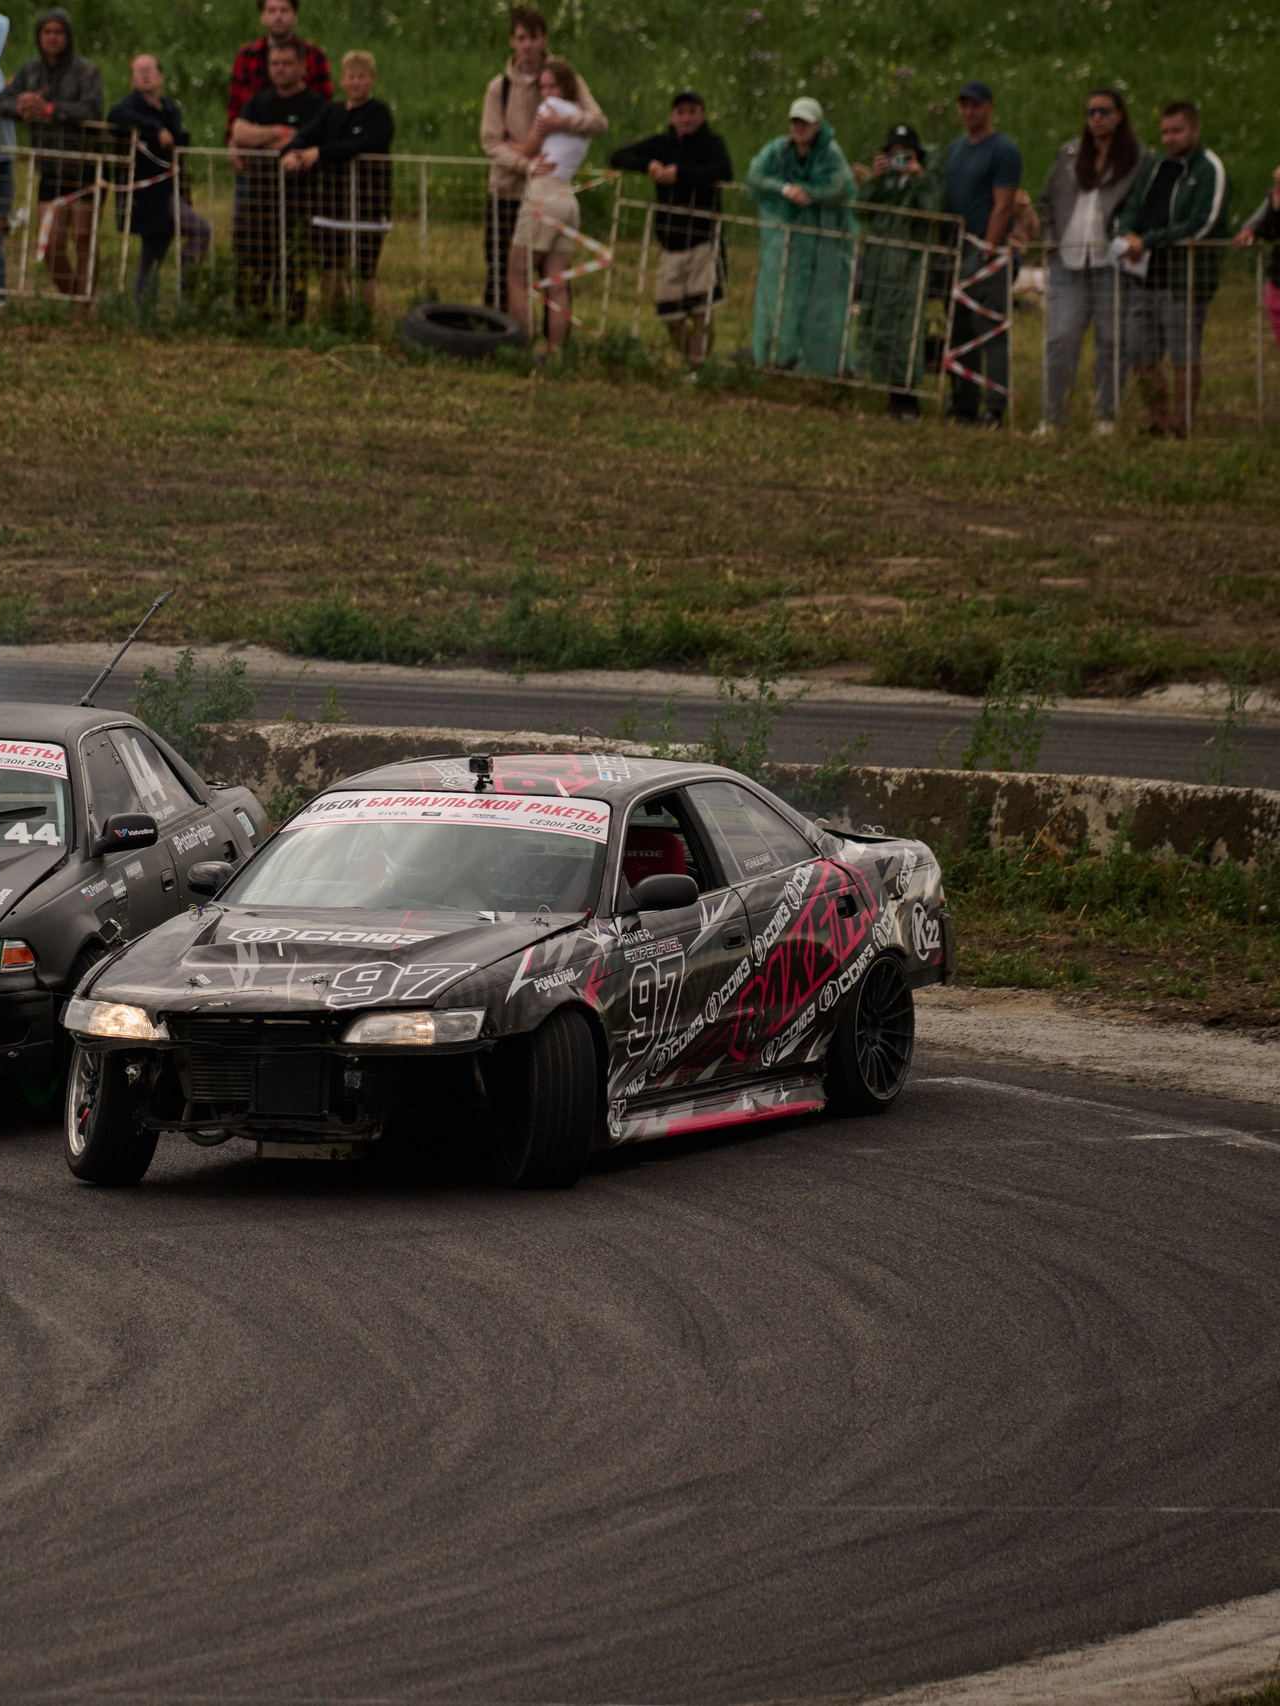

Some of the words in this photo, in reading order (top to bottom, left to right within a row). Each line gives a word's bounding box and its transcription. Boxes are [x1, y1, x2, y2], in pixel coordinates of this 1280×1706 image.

[27, 759, 63, 771] 2025
[121, 738, 168, 806] 44
[302, 798, 367, 815] КУБОК
[365, 796, 521, 811] БАРНАУЛЬСКОЙ
[526, 802, 609, 824] РАКЕТЫ
[4, 822, 61, 846] 44
[128, 828, 154, 836] Valvoline
[172, 824, 216, 855] #PotatoFighter
[529, 818, 566, 828] СЕЗОН
[568, 822, 603, 835] 2025
[296, 929, 436, 944] СОЮЗ
[622, 928, 654, 945] RIVER
[764, 902, 792, 949] СОЮЗ
[325, 961, 478, 1009] 97
[719, 956, 752, 1006] СОЮЗ
[627, 951, 686, 1058] 97
[670, 1013, 704, 1060] СОЮЗ
[778, 1003, 816, 1045] СОЮЗ
